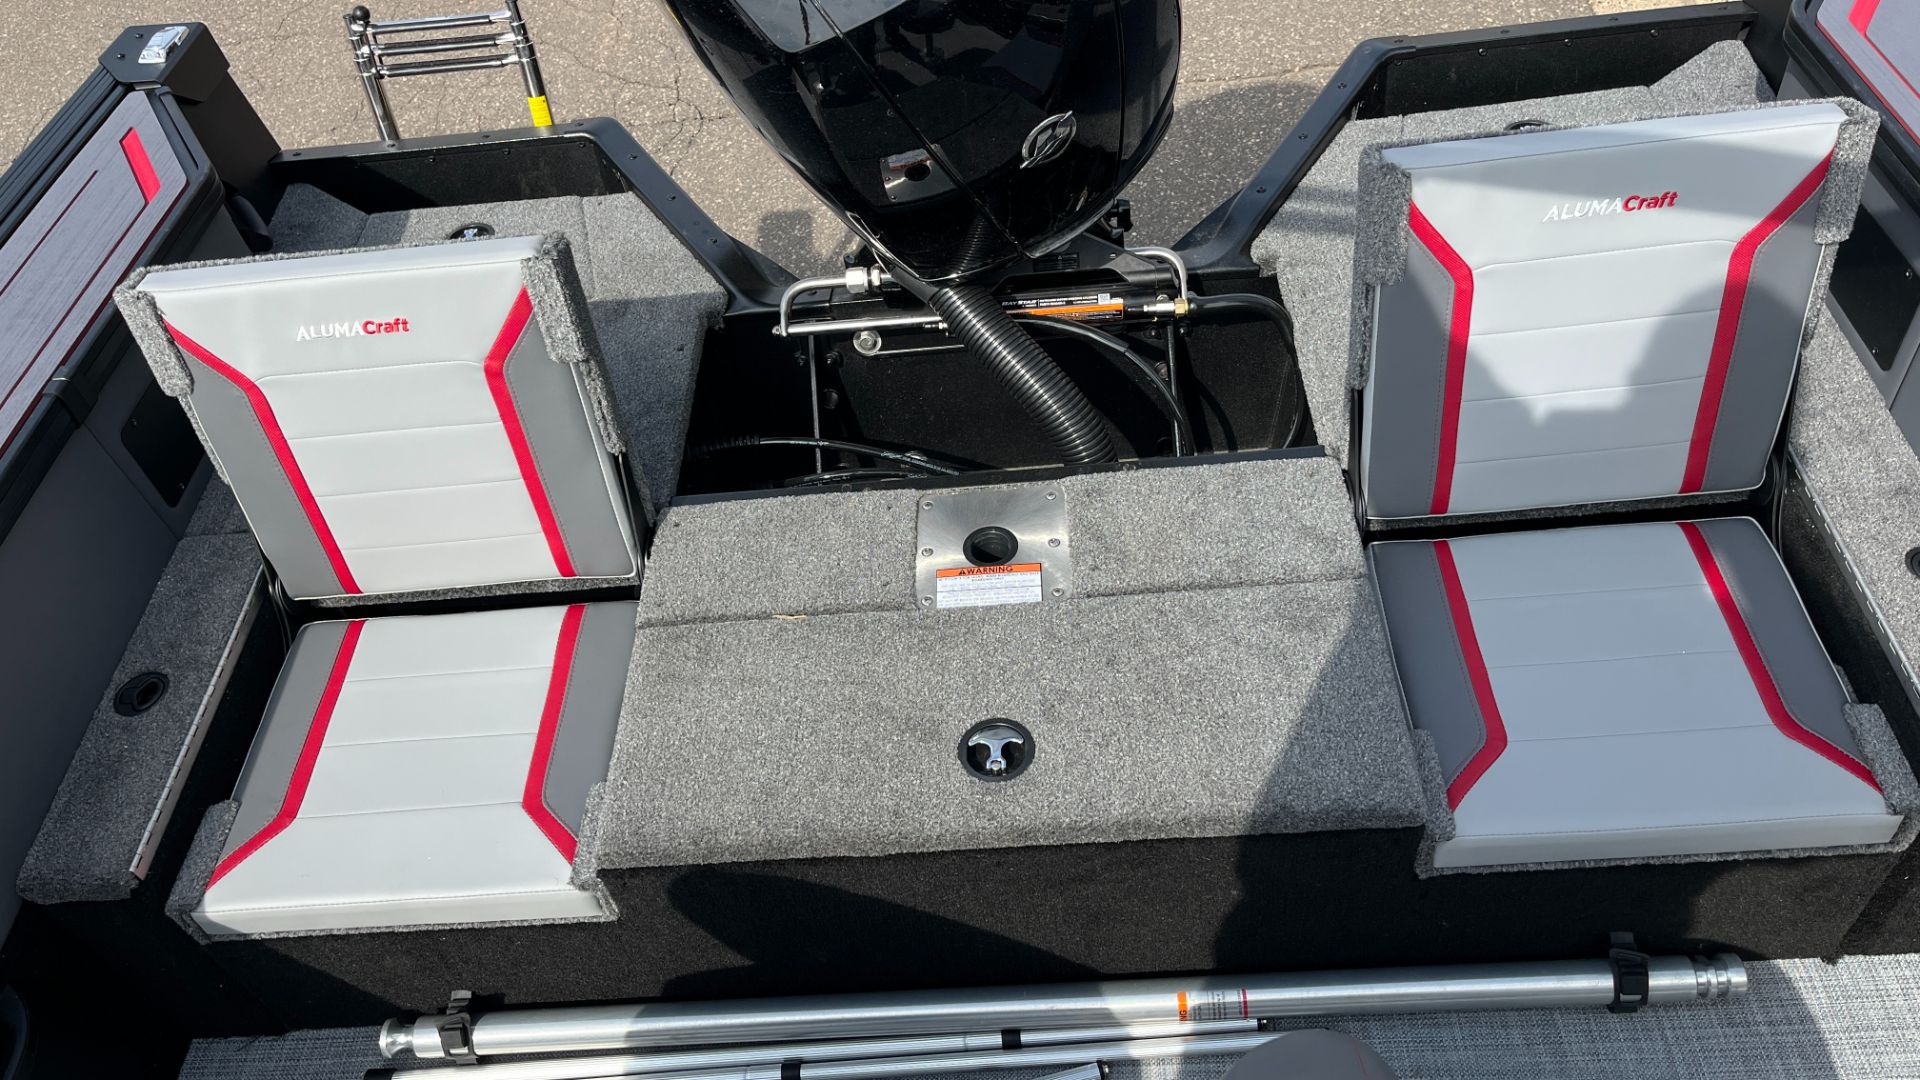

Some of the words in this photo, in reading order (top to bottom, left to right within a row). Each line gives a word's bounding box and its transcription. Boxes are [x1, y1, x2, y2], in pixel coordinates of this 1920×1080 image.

[1543, 191, 1678, 222] ALUMACraft
[296, 317, 410, 342] ALUMACraft
[967, 565, 1014, 576] WARNING
